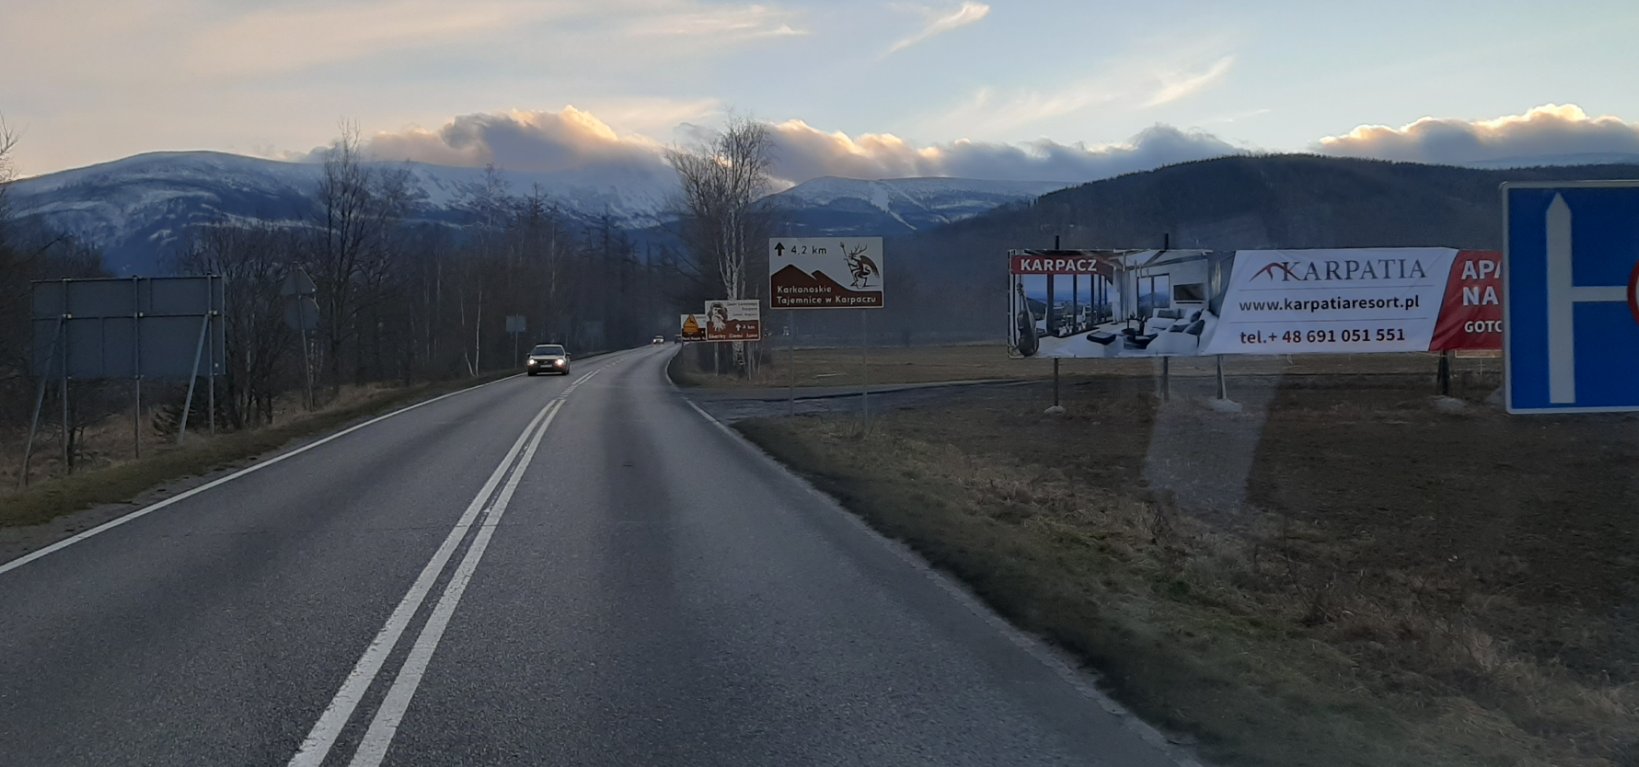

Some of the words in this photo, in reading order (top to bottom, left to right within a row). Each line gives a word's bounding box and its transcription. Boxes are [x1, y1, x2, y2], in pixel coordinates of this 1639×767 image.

[791, 246, 807, 255] 4,2
[812, 246, 827, 254] km
[1020, 259, 1097, 272] KARPACZ
[1281, 259, 1427, 282] KARPATIA
[777, 286, 831, 294] Karkonoskie
[1462, 286, 1499, 306] NA
[777, 296, 822, 305] Tajemnice
[835, 295, 877, 304] Karpaczu
[1239, 295, 1420, 314] www.karpatiaresort.pl
[1282, 331, 1301, 343] 48
[1306, 330, 1335, 343] 691
[1341, 329, 1370, 342] 051
[1376, 328, 1405, 341] 551
